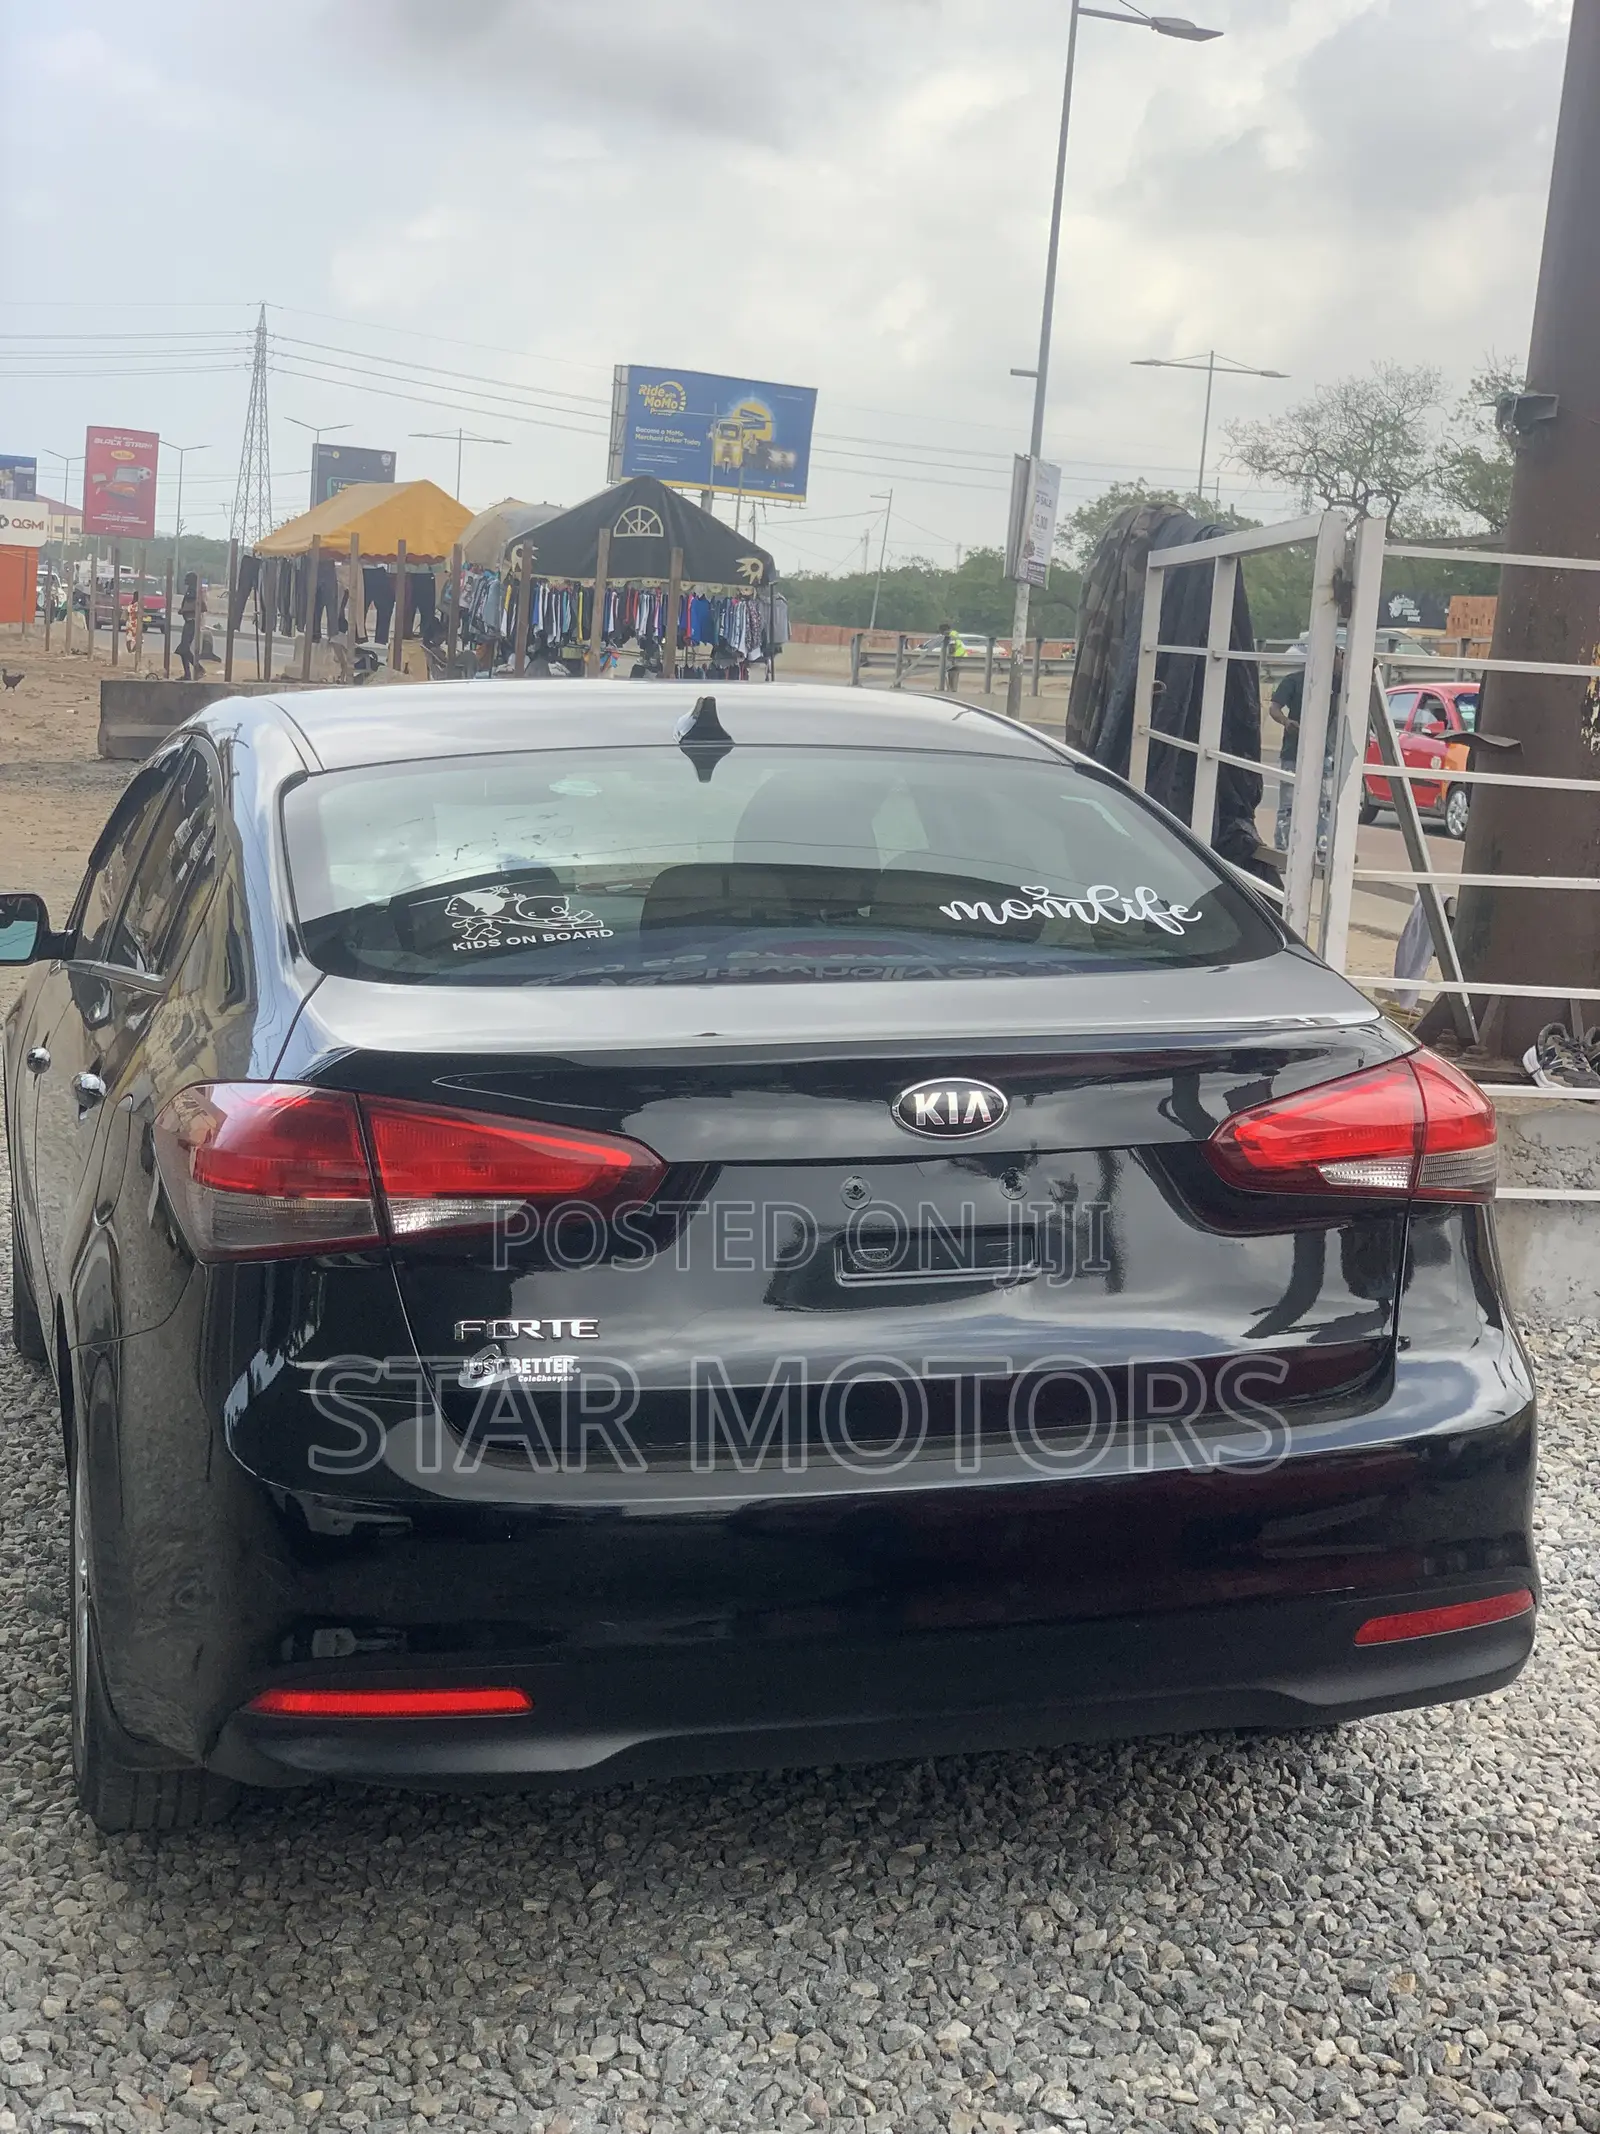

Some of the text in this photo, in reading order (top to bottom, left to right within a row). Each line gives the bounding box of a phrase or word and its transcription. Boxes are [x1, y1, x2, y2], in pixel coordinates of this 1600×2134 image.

[638, 384, 665, 397] Ride
[644, 396, 678, 410] MoMo
[634, 433, 701, 447] Merchant Driver Today
[666, 429, 684, 437] MoMo
[939, 885, 1202, 935] momlife
[452, 928, 615, 951] KIDS ON BOARD
[913, 1090, 992, 1126] KIA
[454, 1319, 599, 1340] FORTE
[463, 1358, 505, 1376] JUST
